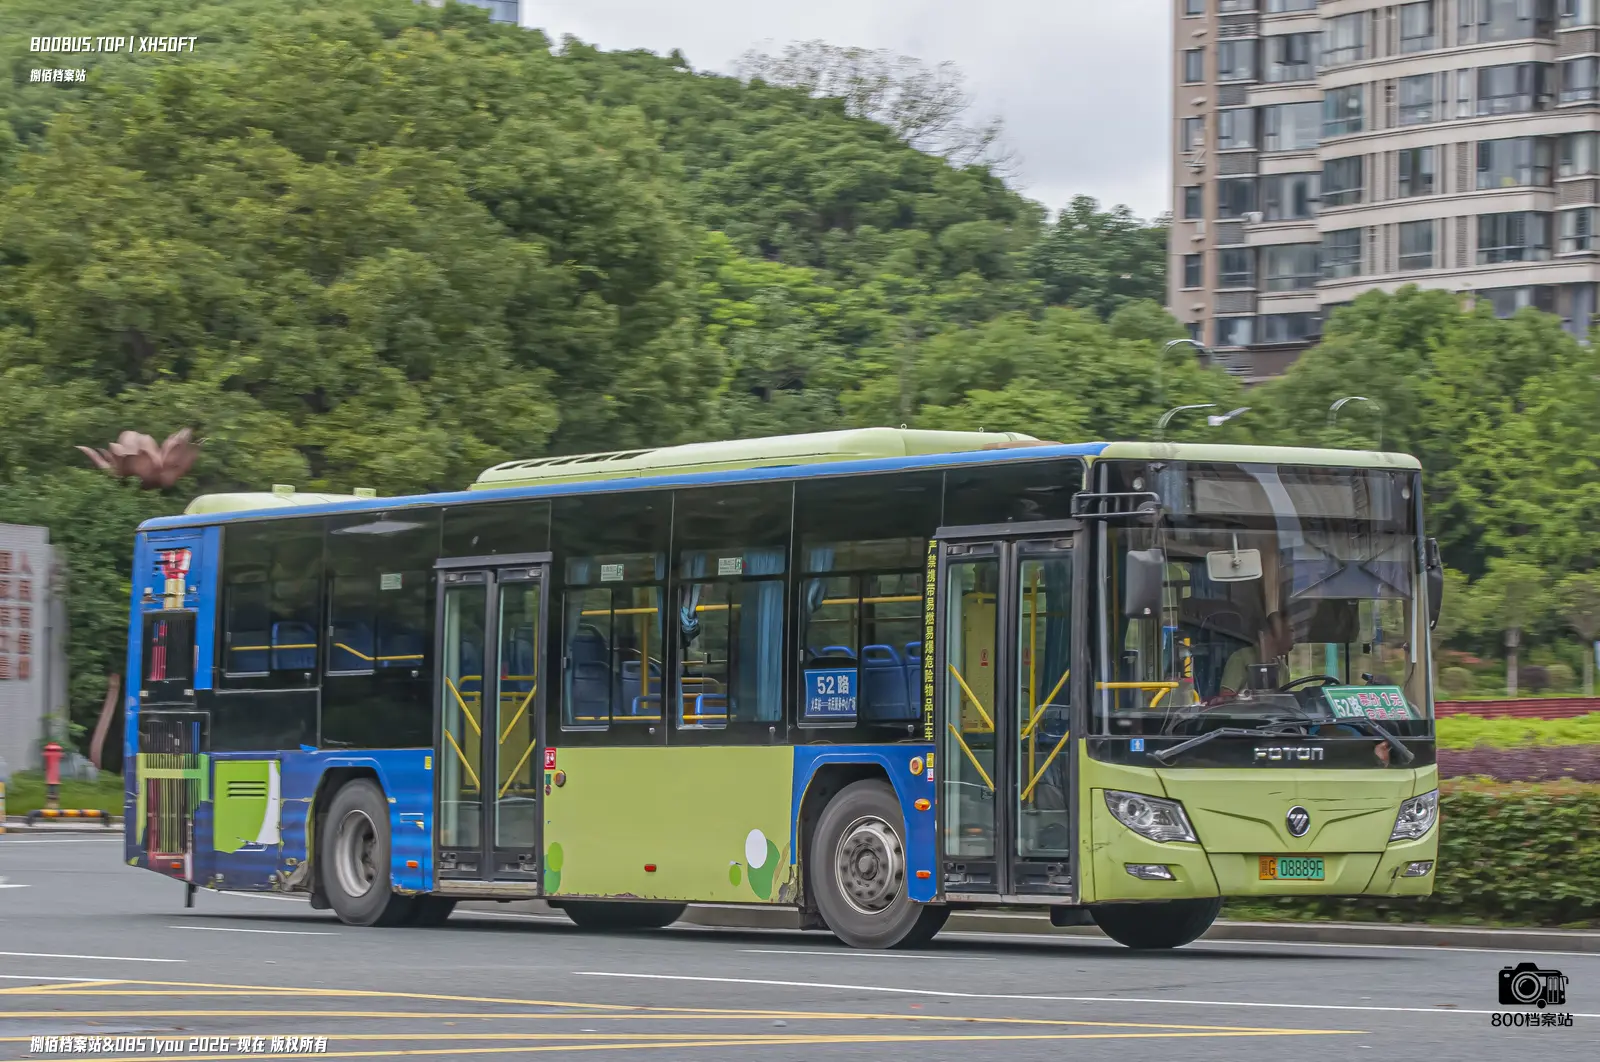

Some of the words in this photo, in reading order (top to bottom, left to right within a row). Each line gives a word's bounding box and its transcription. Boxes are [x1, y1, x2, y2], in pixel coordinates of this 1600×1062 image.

[924, 540, 937, 740] 严禁携带易燃易爆危险物品上车
[1254, 747, 1324, 760] FOTON
[1280, 859, 1324, 877] 08889F
